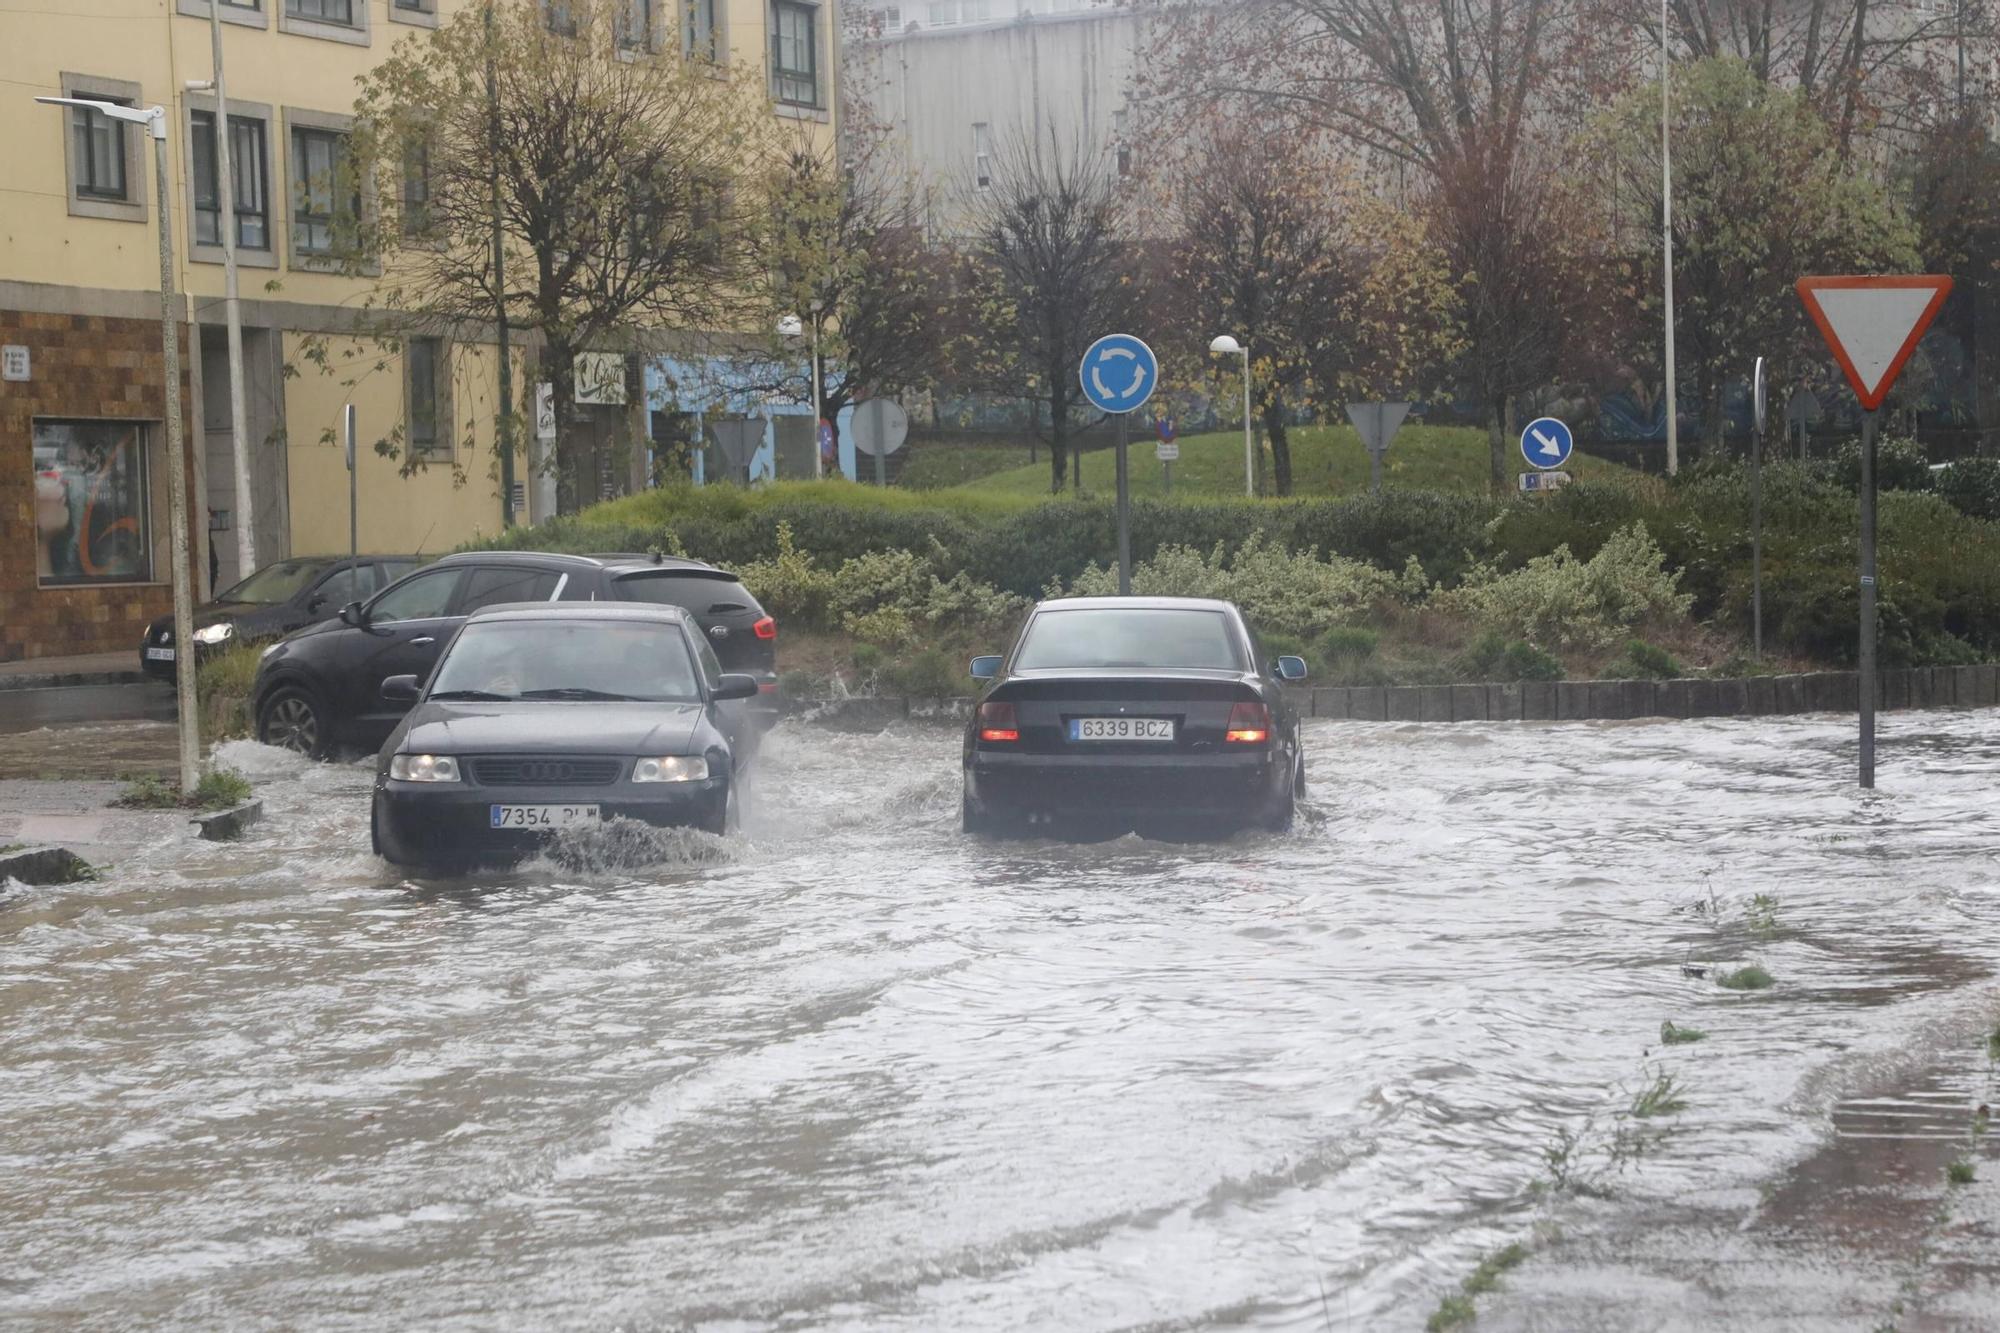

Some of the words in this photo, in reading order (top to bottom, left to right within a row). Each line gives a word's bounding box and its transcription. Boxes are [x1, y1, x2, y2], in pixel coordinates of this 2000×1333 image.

[1083, 721, 1128, 737] 6339
[1135, 721, 1169, 737] BCZ
[502, 808, 550, 825] 7354
